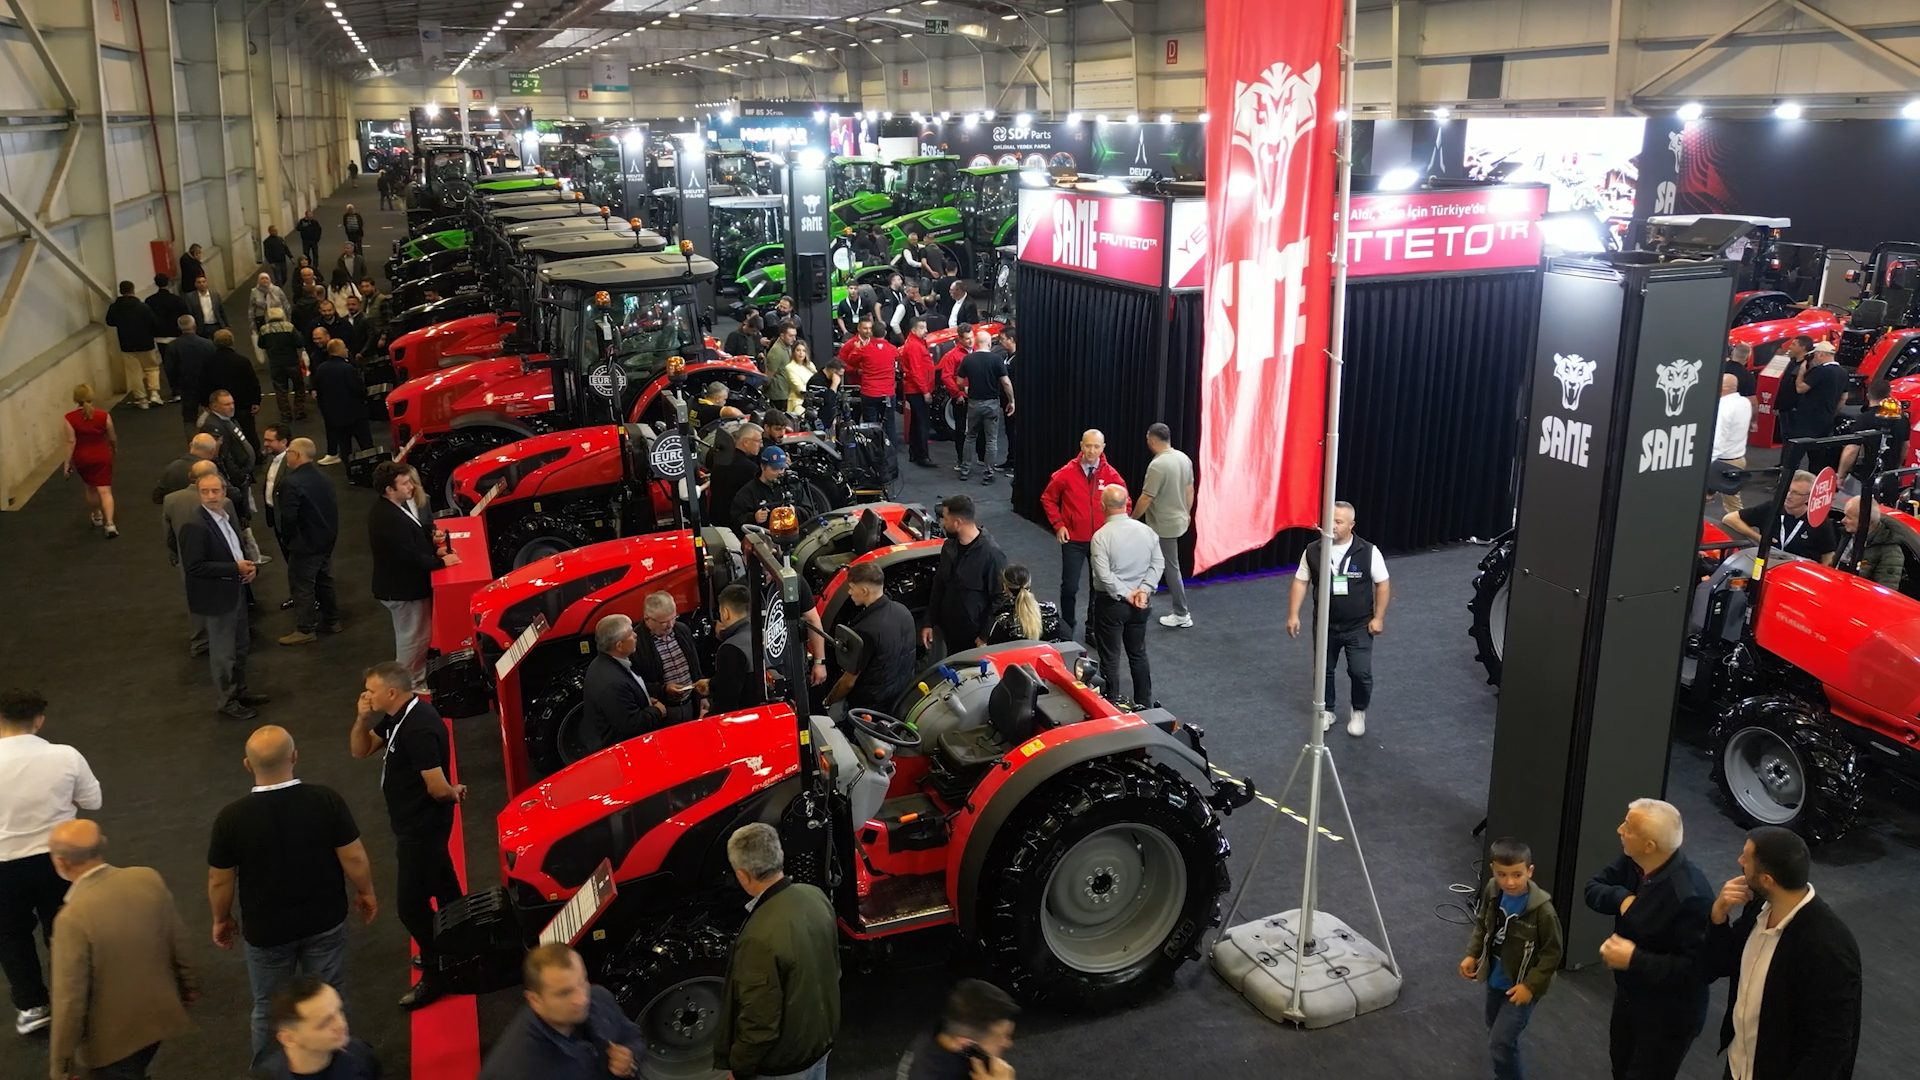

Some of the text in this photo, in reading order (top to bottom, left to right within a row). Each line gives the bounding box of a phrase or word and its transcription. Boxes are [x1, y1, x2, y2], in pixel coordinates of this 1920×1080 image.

[1008, 127, 1052, 140] SDF Parts
[801, 216, 823, 231] SAME
[1052, 198, 1099, 270] SAME
[1332, 224, 1494, 263] TTETO
[592, 377, 612, 385] EUR
[1539, 415, 1592, 468] SAME
[1638, 423, 1697, 473] SAME
